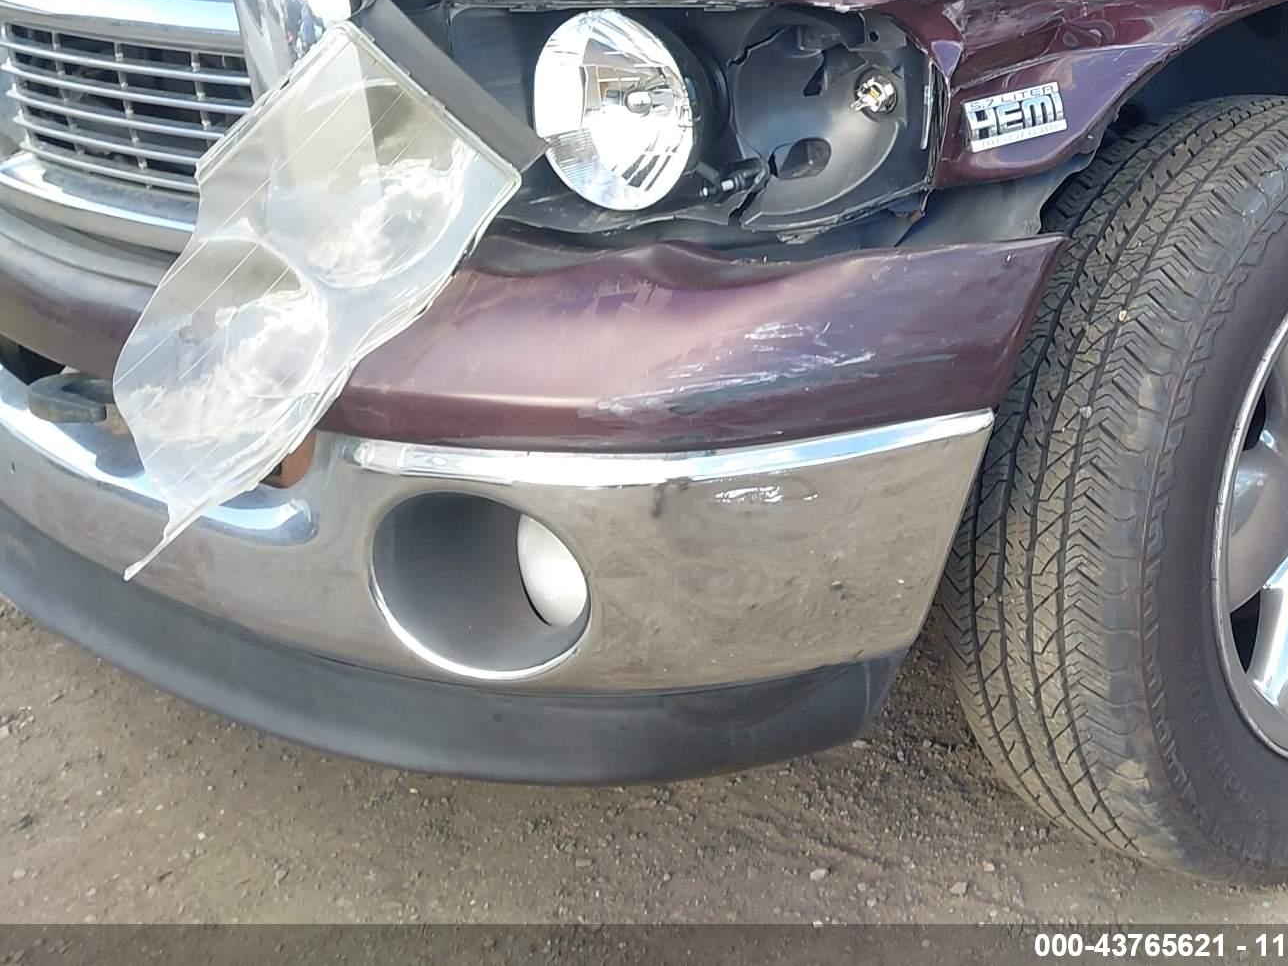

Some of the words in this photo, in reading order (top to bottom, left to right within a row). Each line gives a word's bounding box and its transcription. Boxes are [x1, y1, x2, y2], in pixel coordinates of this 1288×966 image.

[970, 98, 995, 110] 5.7
[1001, 85, 1054, 103] LITER
[967, 92, 1064, 141] HEMI
